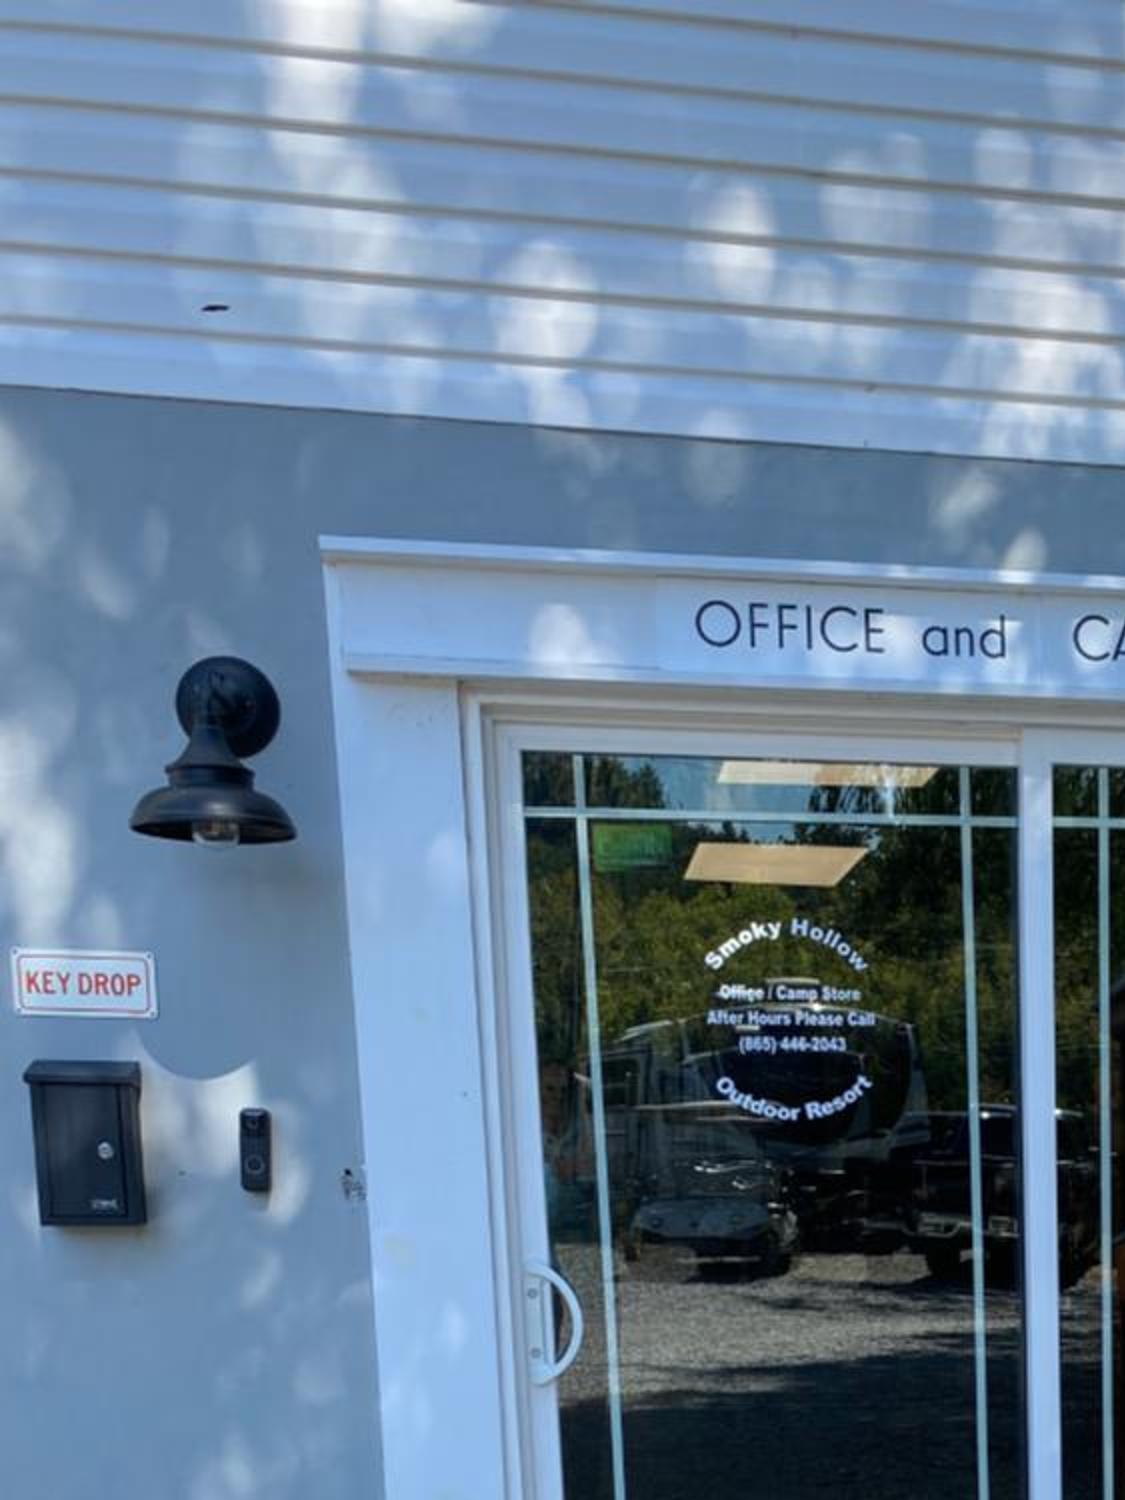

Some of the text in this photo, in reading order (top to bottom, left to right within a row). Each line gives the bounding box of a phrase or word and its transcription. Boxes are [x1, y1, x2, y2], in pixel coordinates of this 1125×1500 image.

[695, 600, 885, 654] OFFICE
[921, 615, 1007, 660] and
[704, 918, 869, 972] Smoky Hollow
[25, 970, 142, 997] KEY DROP
[719, 984, 765, 1002] Office
[776, 985, 818, 1004] Camp
[822, 986, 861, 1001] Store
[706, 1010, 876, 1027] After Hours Please Call
[738, 1036, 847, 1055] (865) 446-2043
[715, 1074, 873, 1121] Outdoor Resort
